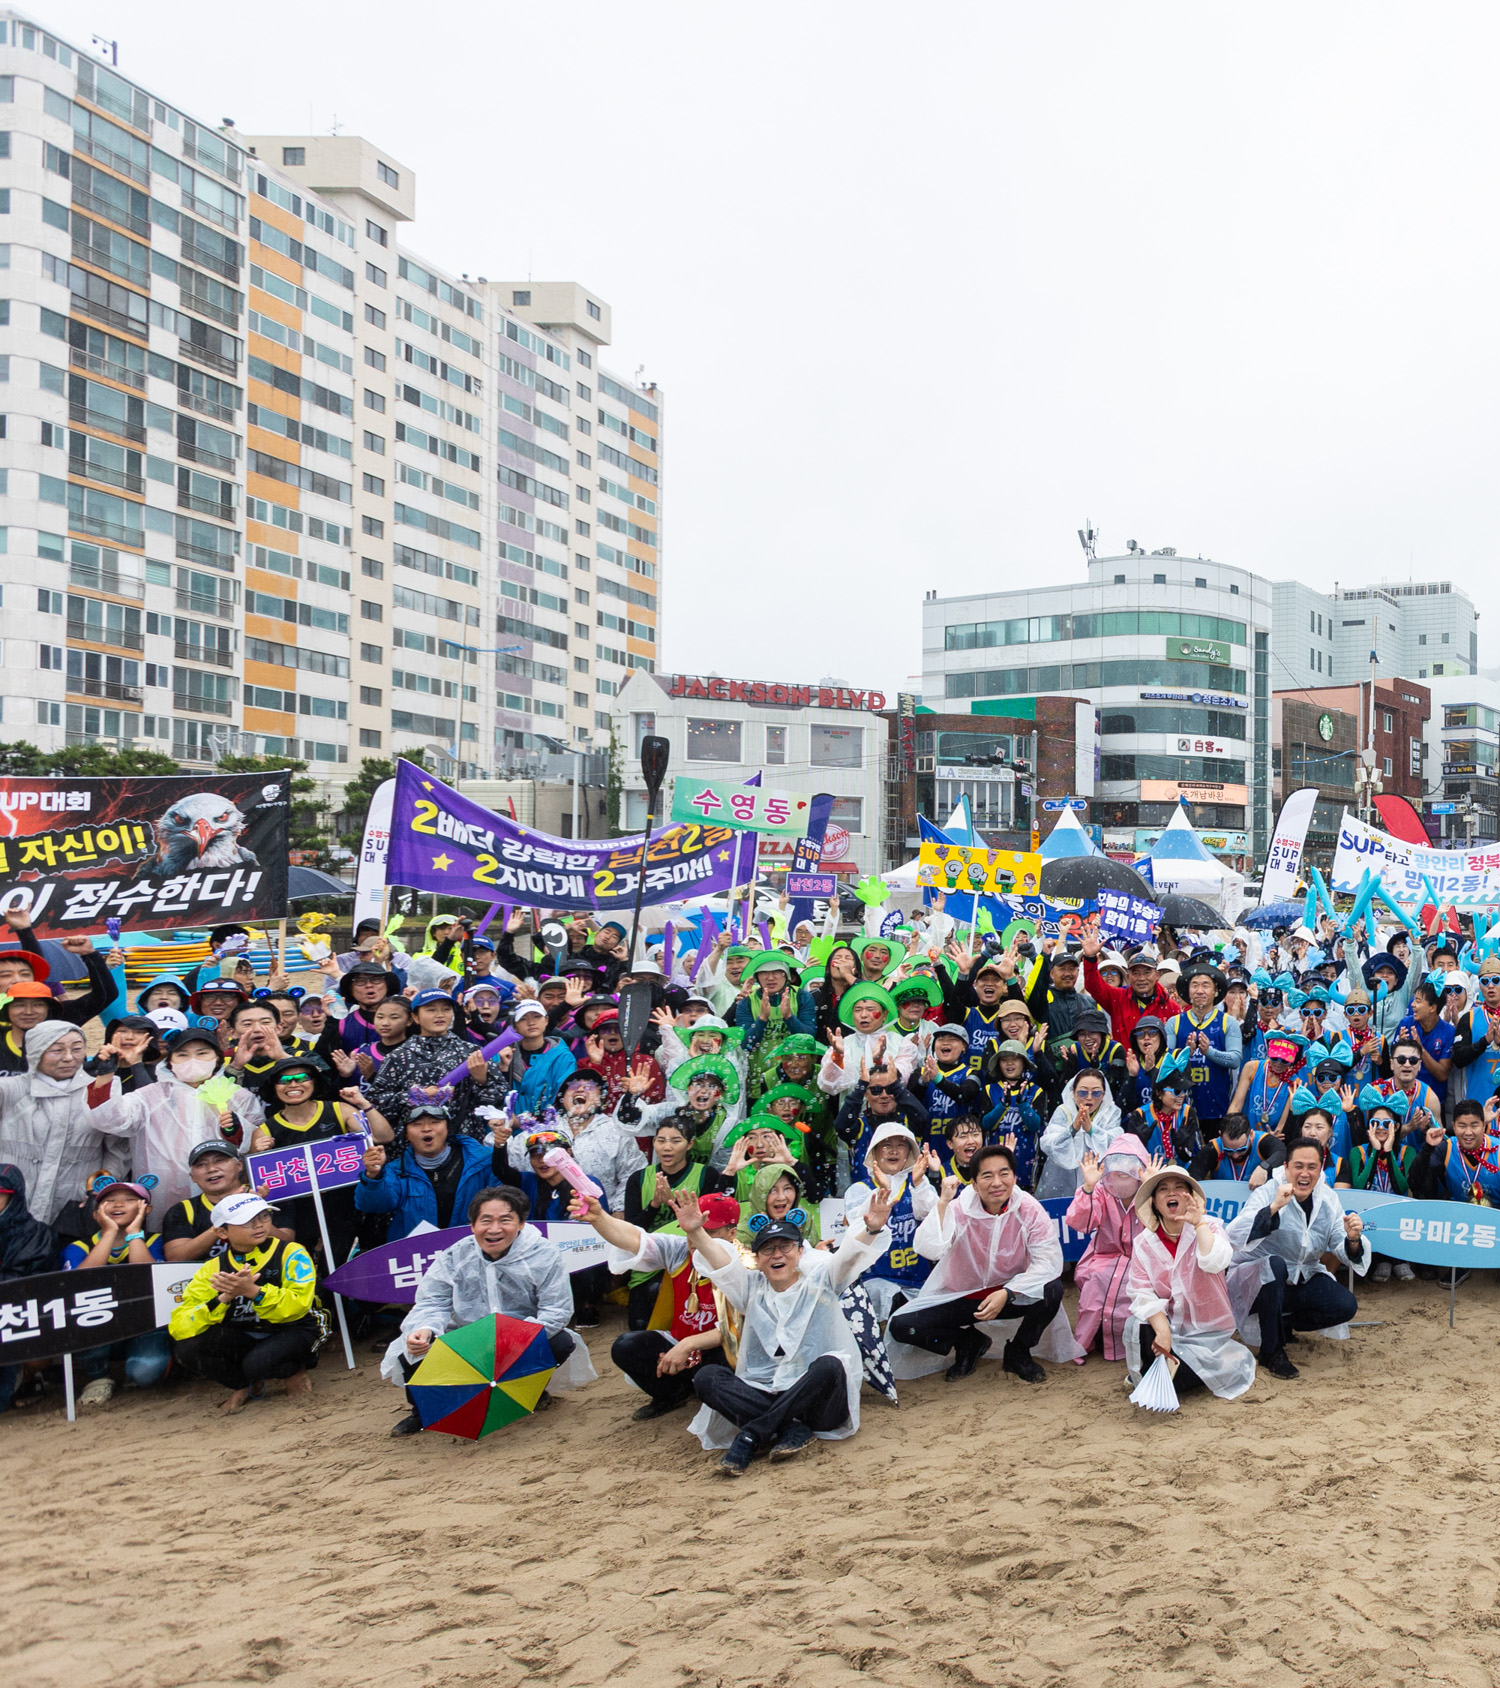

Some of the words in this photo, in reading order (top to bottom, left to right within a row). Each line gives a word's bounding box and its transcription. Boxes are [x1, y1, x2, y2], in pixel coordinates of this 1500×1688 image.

[669, 676, 811, 704] JACKSON
[818, 688, 886, 710] BLVD
[937, 767, 956, 778] LA
[691, 788, 792, 826] 수영동
[19, 825, 147, 867] 자신이!
[411, 799, 495, 854] 2배더
[502, 837, 600, 871] 강력한
[1275, 837, 1301, 850] 수영구민
[1340, 829, 1386, 856] SUP
[1384, 850, 1410, 867] 타고
[1414, 853, 1465, 872] 광안리
[798, 846, 820, 862] SUP
[1272, 846, 1299, 861] SUP
[472, 853, 585, 898] 2지하게
[790, 877, 834, 893] 남천2동
[60, 869, 262, 921] 접수한다!
[1097, 891, 1130, 911] 오늘의
[258, 1145, 363, 1189] 남천2동
[1399, 1217, 1497, 1249] 망미2동
[890, 1247, 920, 1269] 82
